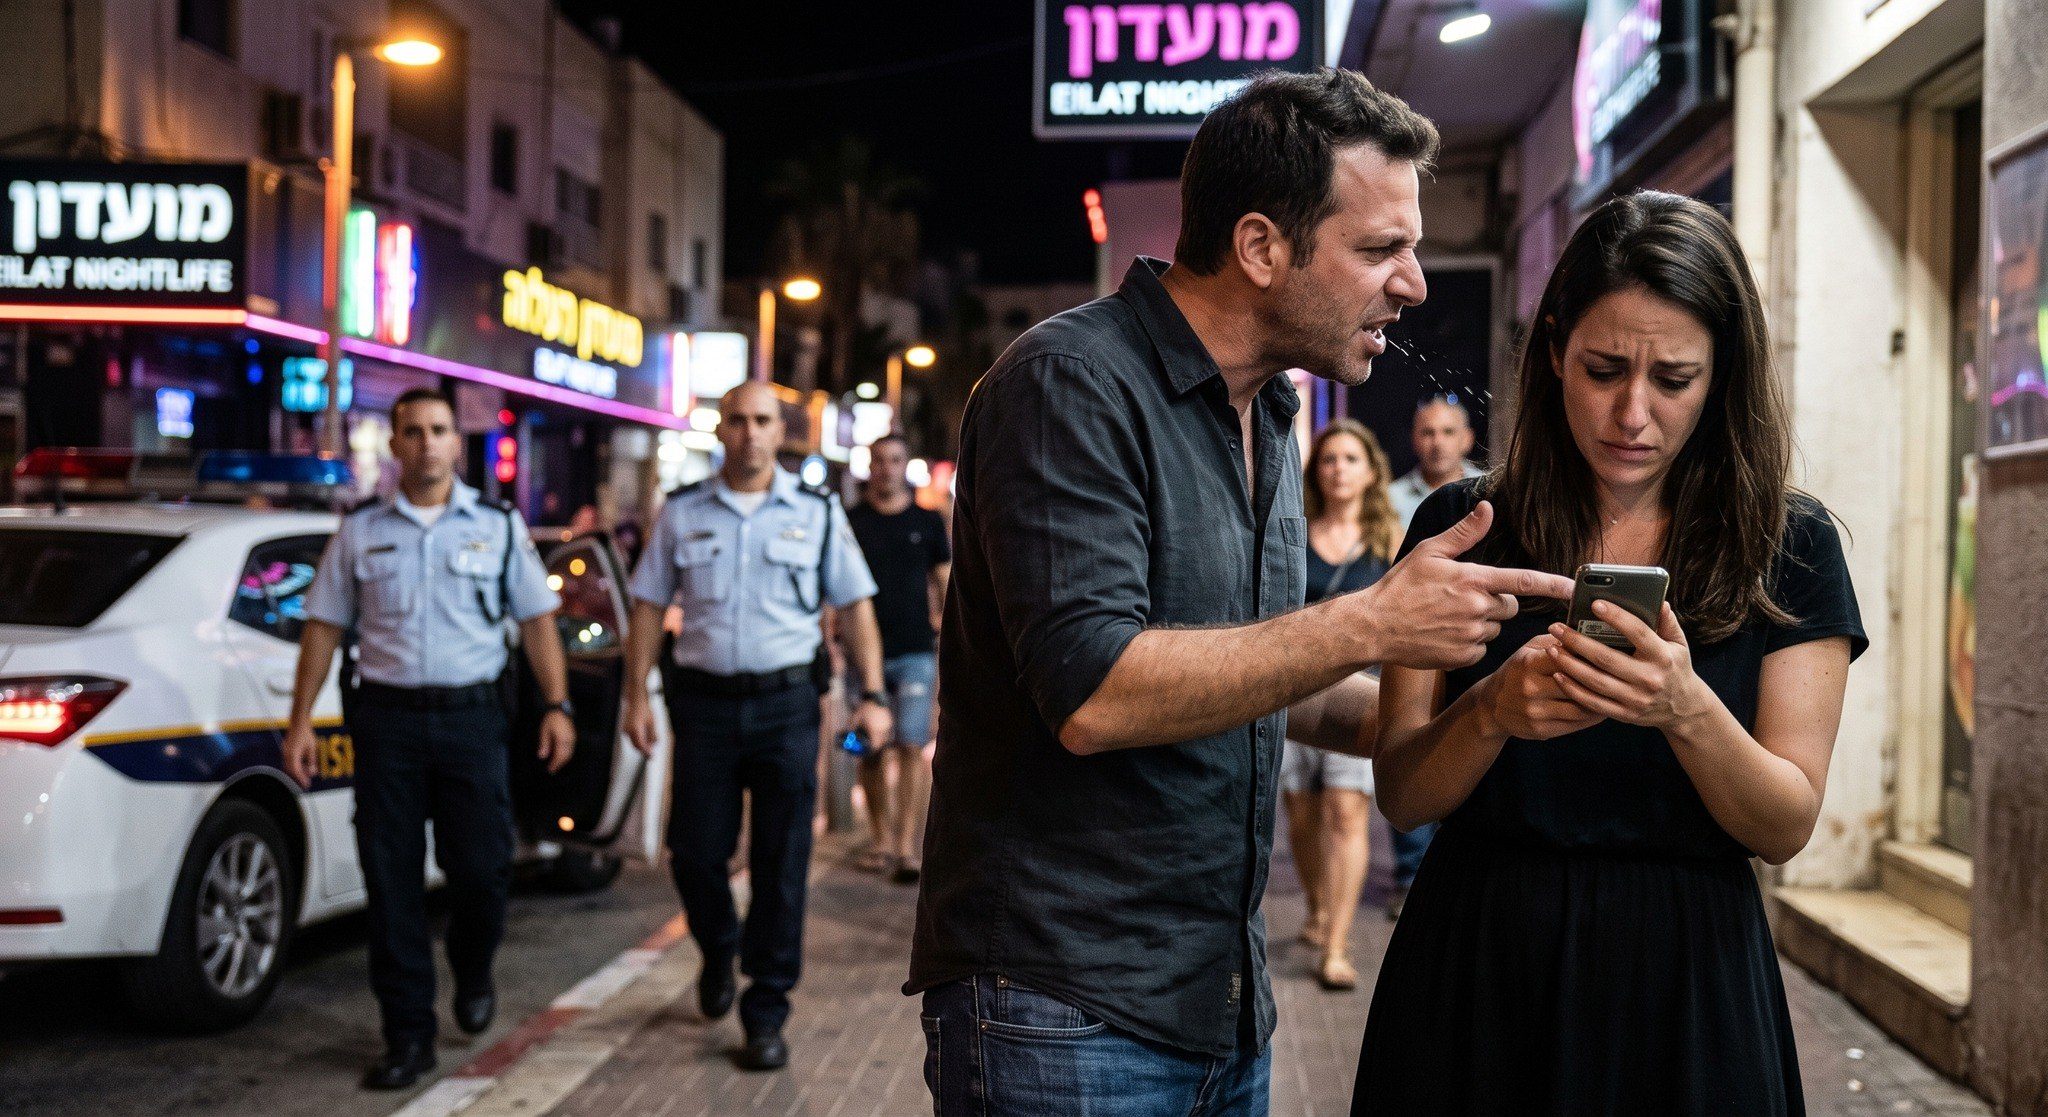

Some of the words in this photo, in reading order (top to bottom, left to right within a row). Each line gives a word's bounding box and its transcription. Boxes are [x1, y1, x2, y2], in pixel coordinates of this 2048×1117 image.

[1063, 2, 1301, 78] מועדון
[1050, 81, 1143, 115] EILAT
[8, 180, 233, 254] מועדון
[0, 255, 72, 289] ILAT
[73, 256, 233, 293] NIGHTLIFE
